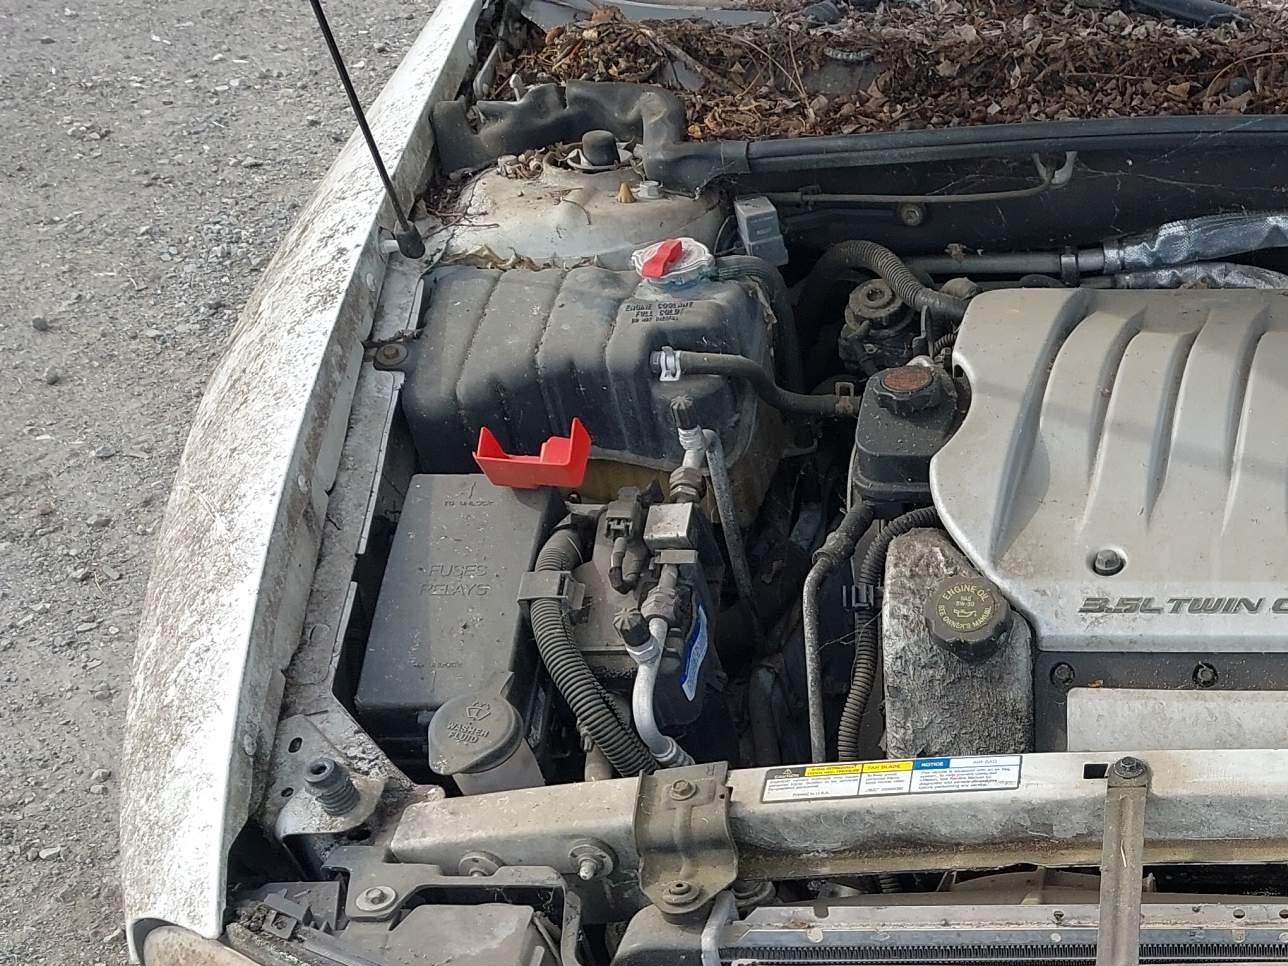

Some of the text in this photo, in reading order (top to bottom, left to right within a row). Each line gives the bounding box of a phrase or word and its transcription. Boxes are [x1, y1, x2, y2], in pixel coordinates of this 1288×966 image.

[429, 564, 488, 577] FUSES
[420, 583, 491, 597] RELAYS
[942, 584, 989, 602] ENGINE OIL
[1078, 597, 1164, 615] 3.5L
[1167, 597, 1265, 615] TWIN
[447, 721, 490, 738] WASHER
[448, 731, 480, 744] FLUID
